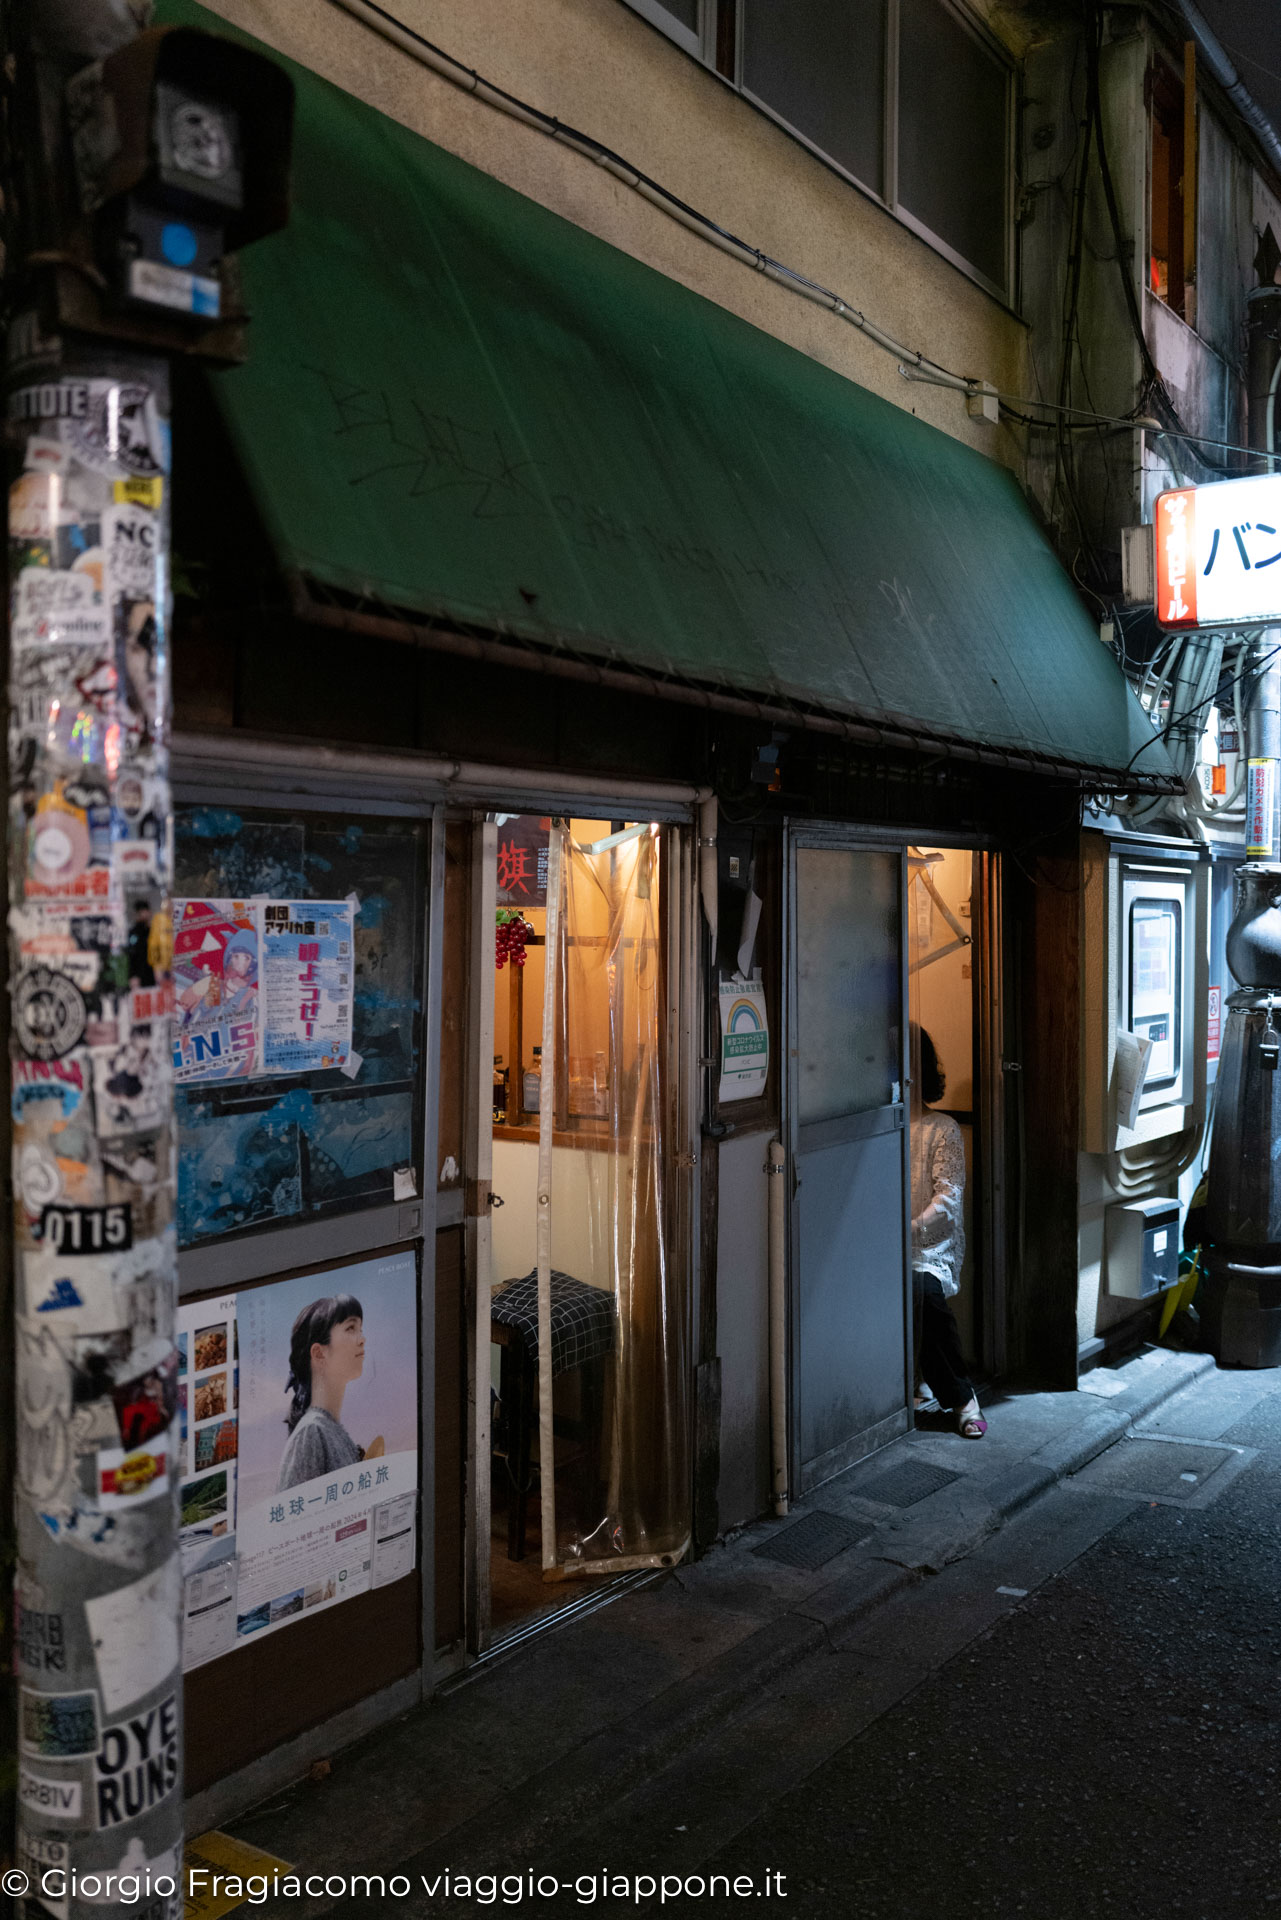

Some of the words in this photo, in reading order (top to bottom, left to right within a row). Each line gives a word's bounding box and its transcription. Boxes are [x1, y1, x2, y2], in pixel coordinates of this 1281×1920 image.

[1164, 496, 1189, 620] サッロビール
[1203, 521, 1281, 576] バン
[265, 905, 290, 921] 劇団
[265, 921, 316, 936] アフリカ座
[45, 1208, 127, 1250] 0115
[269, 1465, 390, 1524] 地球一周の船旅
[97, 1694, 176, 1775] OYE
[97, 1742, 177, 1828] RUNS
